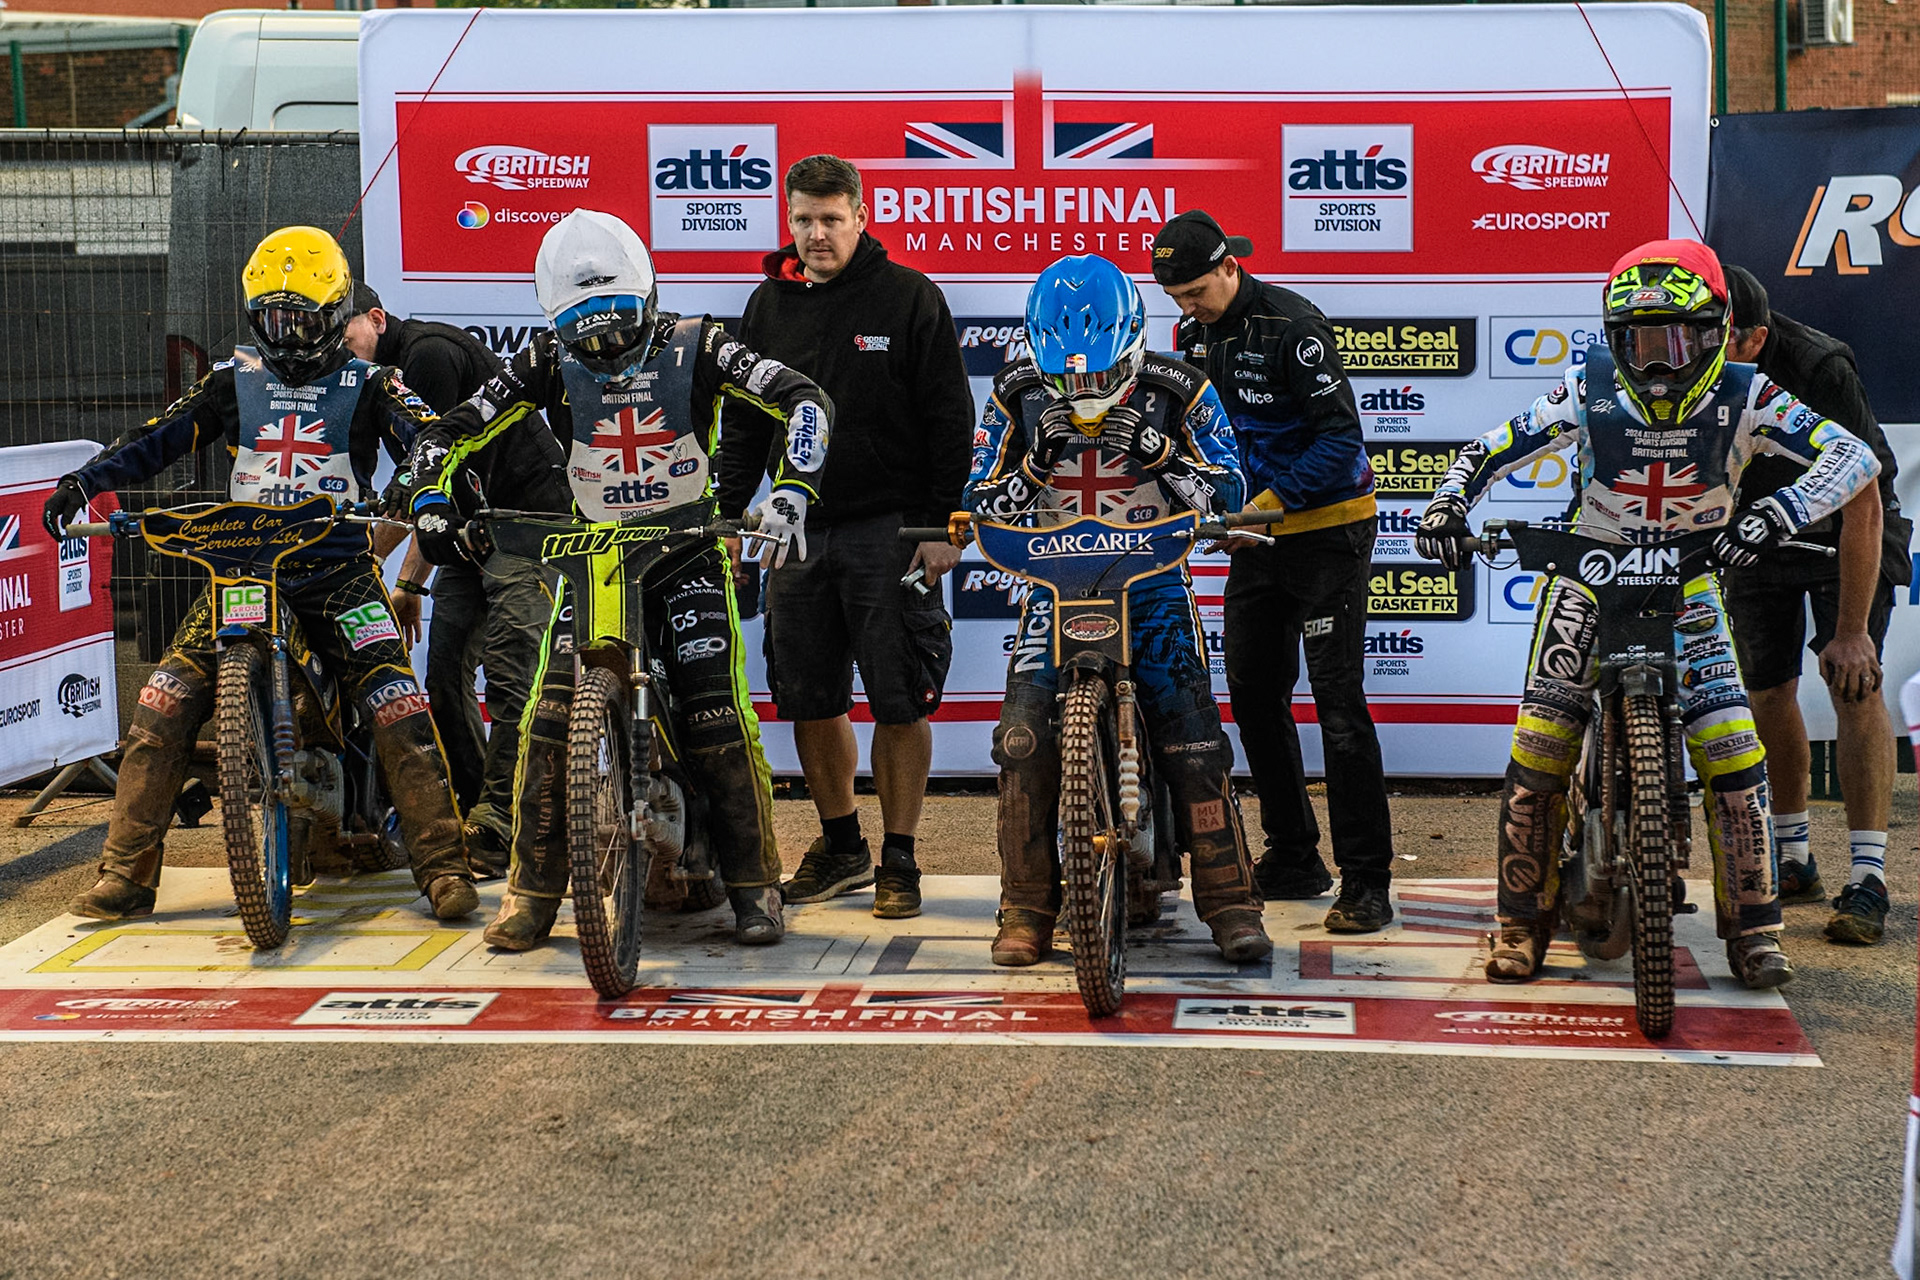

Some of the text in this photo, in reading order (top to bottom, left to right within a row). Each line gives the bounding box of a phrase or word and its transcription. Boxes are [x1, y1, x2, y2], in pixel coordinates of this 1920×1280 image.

[493, 155, 590, 175] BRITISH
[655, 144, 773, 190] attis
[1288, 144, 1407, 190] attis
[1510, 153, 1610, 175] BRITISH
[526, 177, 590, 189] SPEEDWAY
[1544, 176, 1609, 188] SPEEDWAY
[686, 202, 742, 215] SPORTS
[874, 187, 1179, 223] BRITISH FINAL
[1319, 203, 1376, 216] SPORTS
[494, 206, 577, 225] discover
[1476, 212, 1610, 230] EUROSPORT
[681, 218, 747, 231] DIVISION
[1314, 218, 1381, 231] DIVISION
[906, 232, 1155, 251] MANCHESTER
[575, 313, 622, 328] STAVA
[1335, 326, 1458, 350] Steel Seal
[674, 347, 685, 367] 1
[1302, 344, 1319, 360] ATPI
[1341, 354, 1455, 367] EAD GASKET FIX
[339, 370, 357, 387] 16
[1142, 363, 1194, 389] ARCAREK
[294, 392, 318, 400] DIVISION
[602, 392, 653, 404] BRITISH FINAL
[1145, 392, 1156, 412] 2
[1238, 388, 1274, 404] Nice
[1361, 385, 1425, 410] attis
[270, 401, 317, 412] BRITISH FINAL
[1717, 406, 1730, 426] 9
[1624, 428, 1698, 439] 2024 ATTIS INSURANCE
[1634, 437, 1687, 447] SPORTS DIVISION
[1632, 447, 1688, 458] BRITISH FINAL
[1401, 449, 1457, 472] Seal
[676, 461, 693, 474] SCB
[325, 480, 343, 490] SCB
[603, 475, 670, 504] attis
[1373, 477, 1429, 489] GASKET
[620, 508, 654, 519] SPORTS
[1133, 509, 1152, 521] SCB
[1700, 509, 1721, 522] SCB
[179, 514, 283, 538] Complete Car
[194, 529, 302, 551] Services Ltd
[1027, 533, 1154, 556] GARCAREK
[1400, 571, 1458, 595] Seal
[1617, 576, 1680, 586] STEELSTOCK
[231, 605, 265, 613] GROUP
[1371, 599, 1455, 611] GASKET FIX
[70, 677, 100, 704] BRITISH
[378, 695, 426, 725] MOLY
[1197, 804, 1218, 817] MU
[1199, 817, 1220, 829] RA
[1746, 793, 1765, 856] BUILDERS
[320, 997, 482, 1009] attis
[608, 1008, 1039, 1021] BRITISH FINAL
[646, 1020, 996, 1028] MANCHESTER
[1448, 1028, 1632, 1038] EUROSPORT
